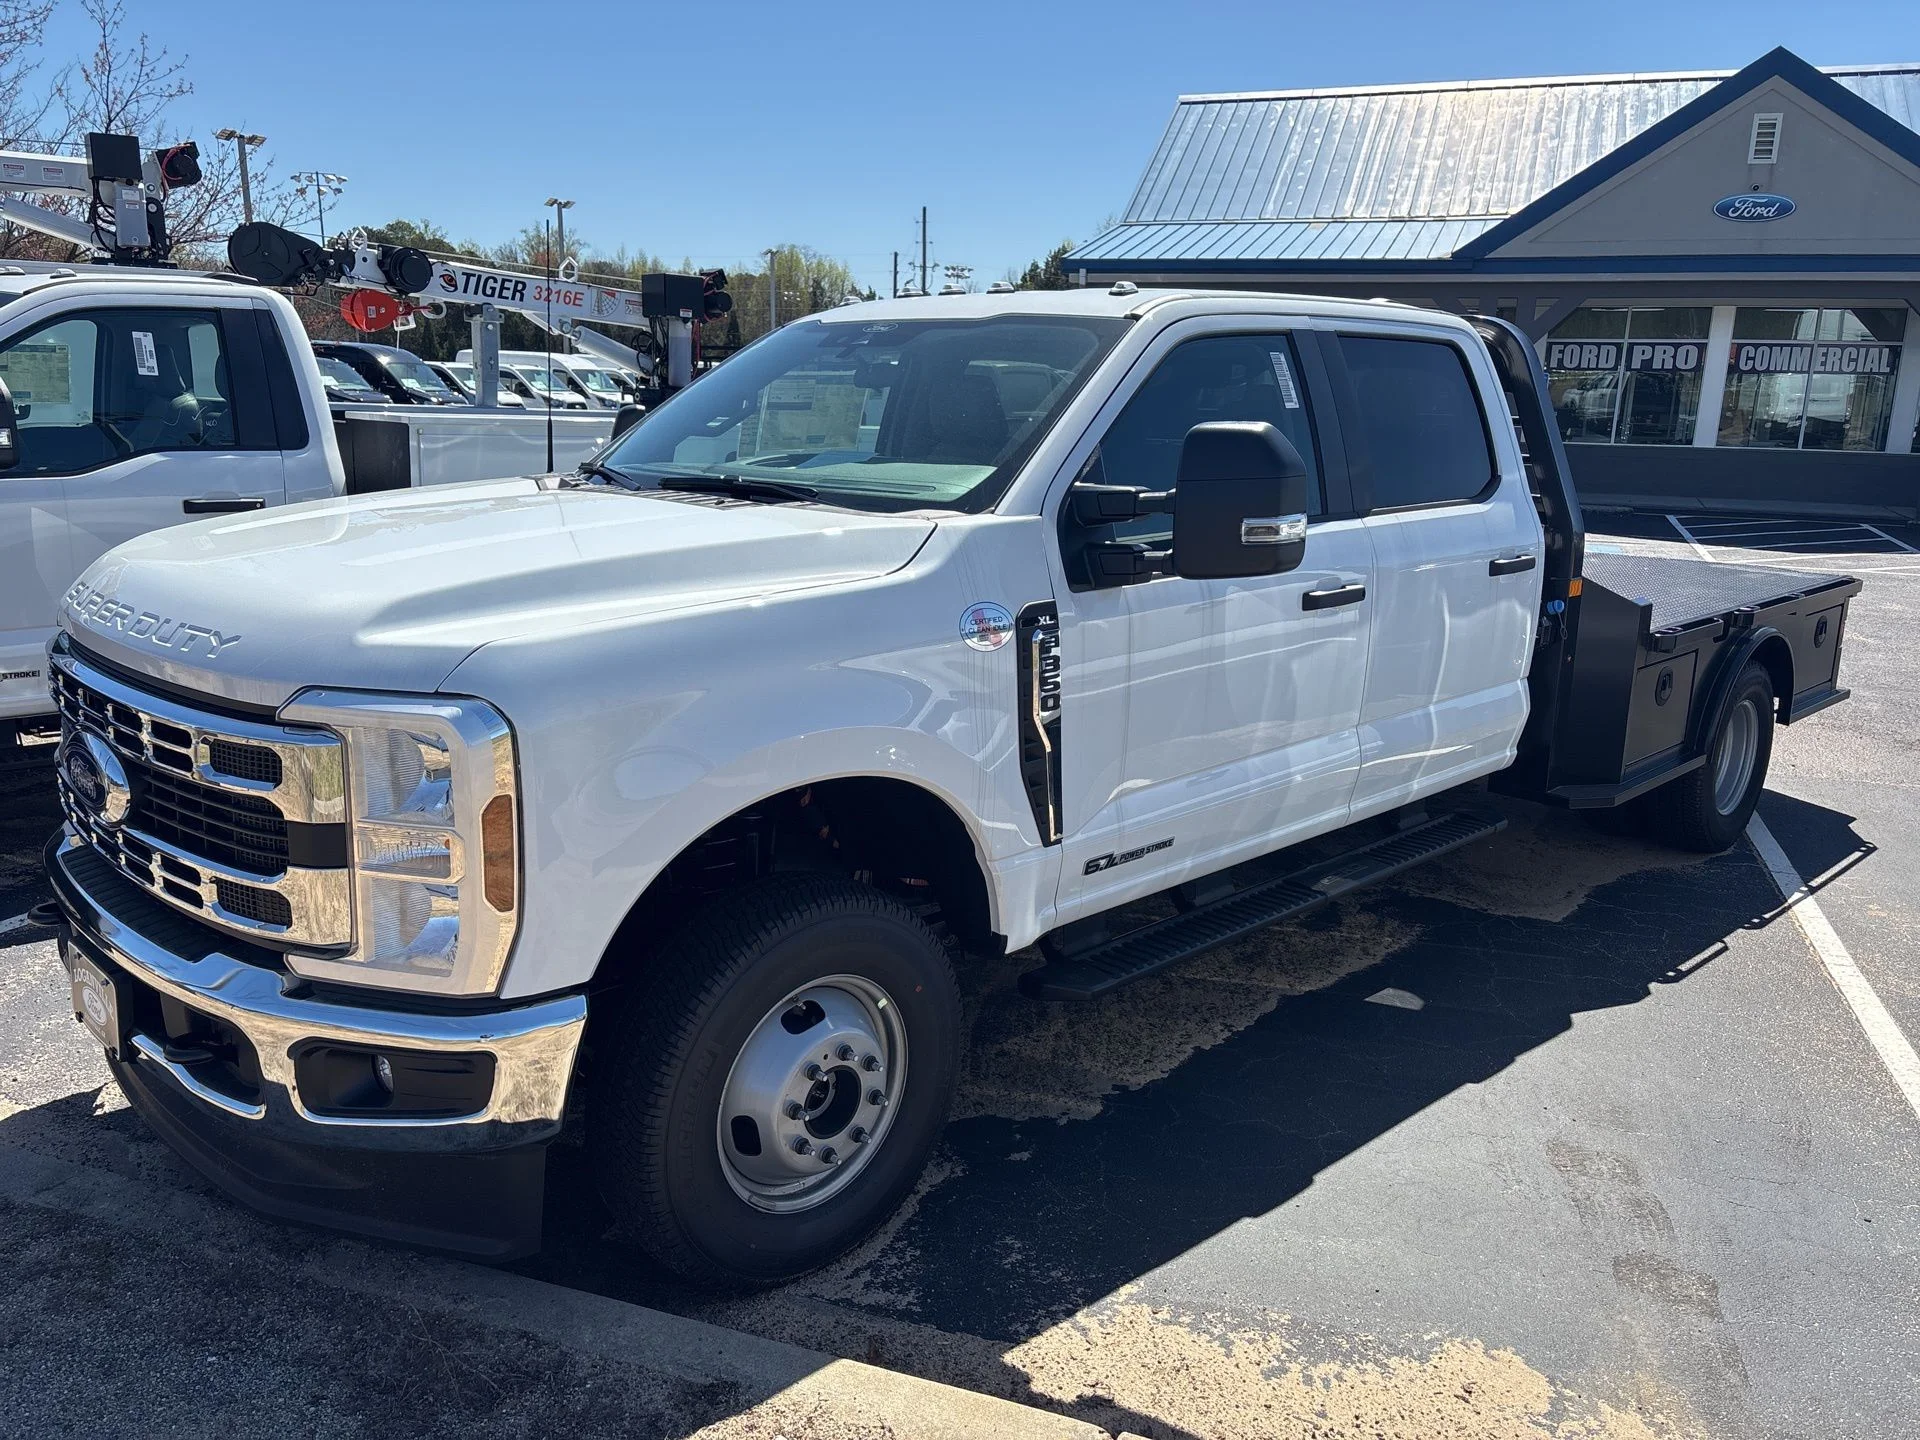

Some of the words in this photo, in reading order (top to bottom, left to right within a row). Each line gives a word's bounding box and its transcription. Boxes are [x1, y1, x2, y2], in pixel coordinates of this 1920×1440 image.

[1728, 197, 1780, 217] Ford
[461, 271, 527, 302] TIGER
[533, 284, 585, 307] 3216E
[1549, 344, 1616, 369] FORD
[1631, 344, 1700, 370] PRO
[1738, 345, 1891, 373] COMMERCIAL
[66, 580, 135, 631] SUPER
[127, 611, 242, 659] DUTY
[968, 625, 991, 634] CLEAN
[969, 616, 1003, 626] CERTIFIED
[1037, 615, 1055, 626] XL
[1039, 633, 1061, 712] F350
[71, 755, 97, 800] Ford
[1083, 852, 1118, 876] 6.7L
[1119, 847, 1146, 862] POWER
[1145, 838, 1175, 854] STROKE
[87, 992, 102, 1020] Ford
